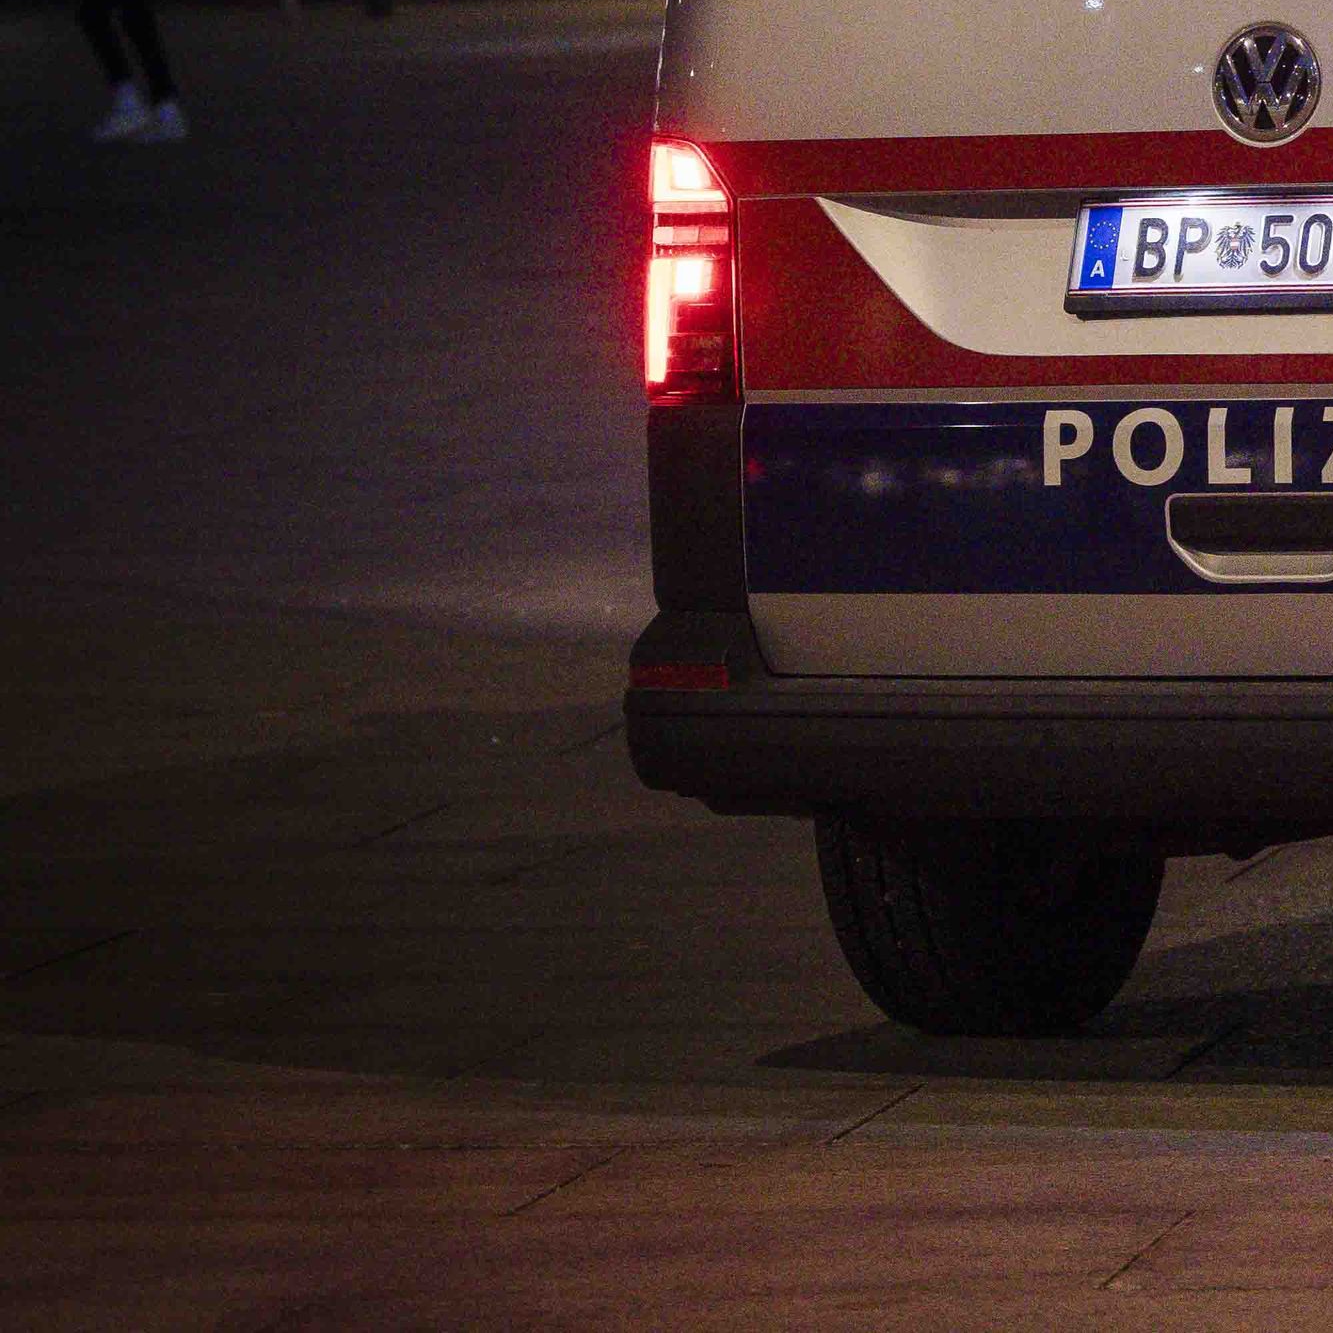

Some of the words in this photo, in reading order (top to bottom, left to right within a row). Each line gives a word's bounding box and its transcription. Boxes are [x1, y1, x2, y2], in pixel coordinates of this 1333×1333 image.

[1215, 24, 1319, 142] VW
[1090, 259, 1105, 277] A
[1133, 217, 1211, 280] BP
